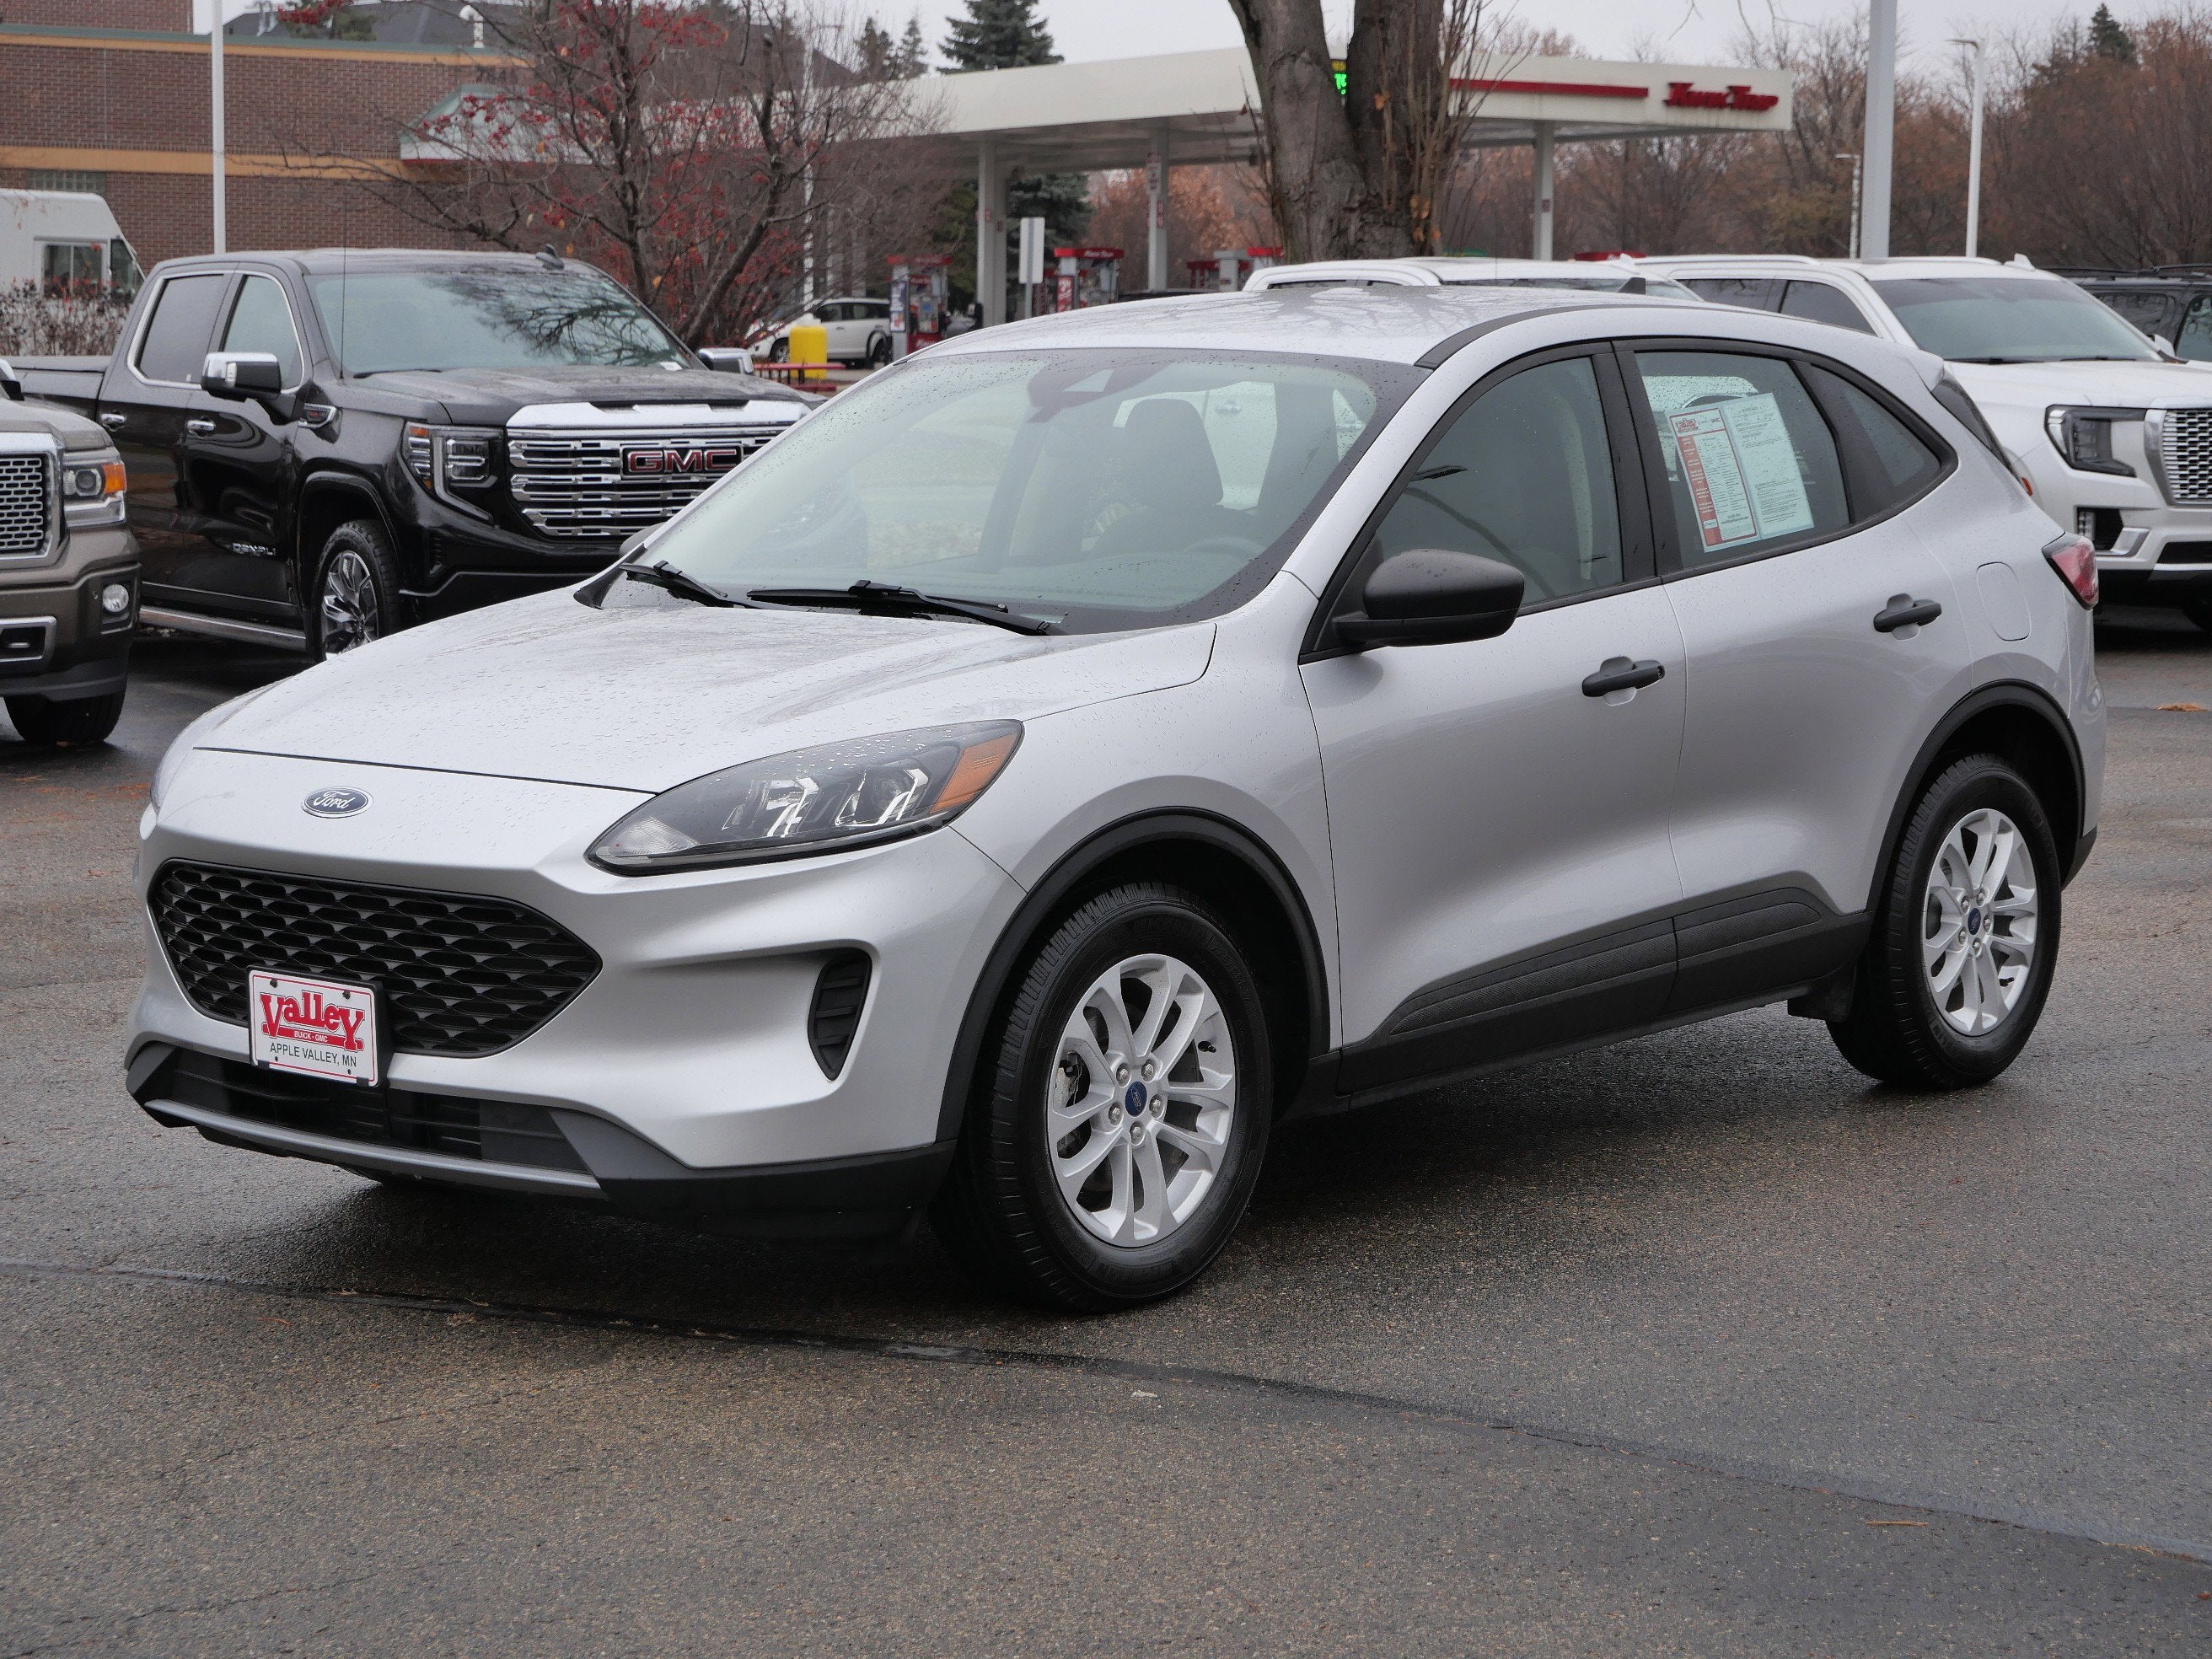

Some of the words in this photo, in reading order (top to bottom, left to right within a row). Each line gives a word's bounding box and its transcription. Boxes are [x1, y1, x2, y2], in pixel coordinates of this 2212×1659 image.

[627, 449, 737, 473] GMC
[313, 790, 356, 809] Ford
[260, 990, 365, 1052] Valley
[294, 1030, 311, 1040] BUICK
[314, 1034, 329, 1043] GMC
[270, 1042, 300, 1058] APPLE
[302, 1048, 340, 1066] VALLEY,
[342, 1055, 357, 1067] MN
